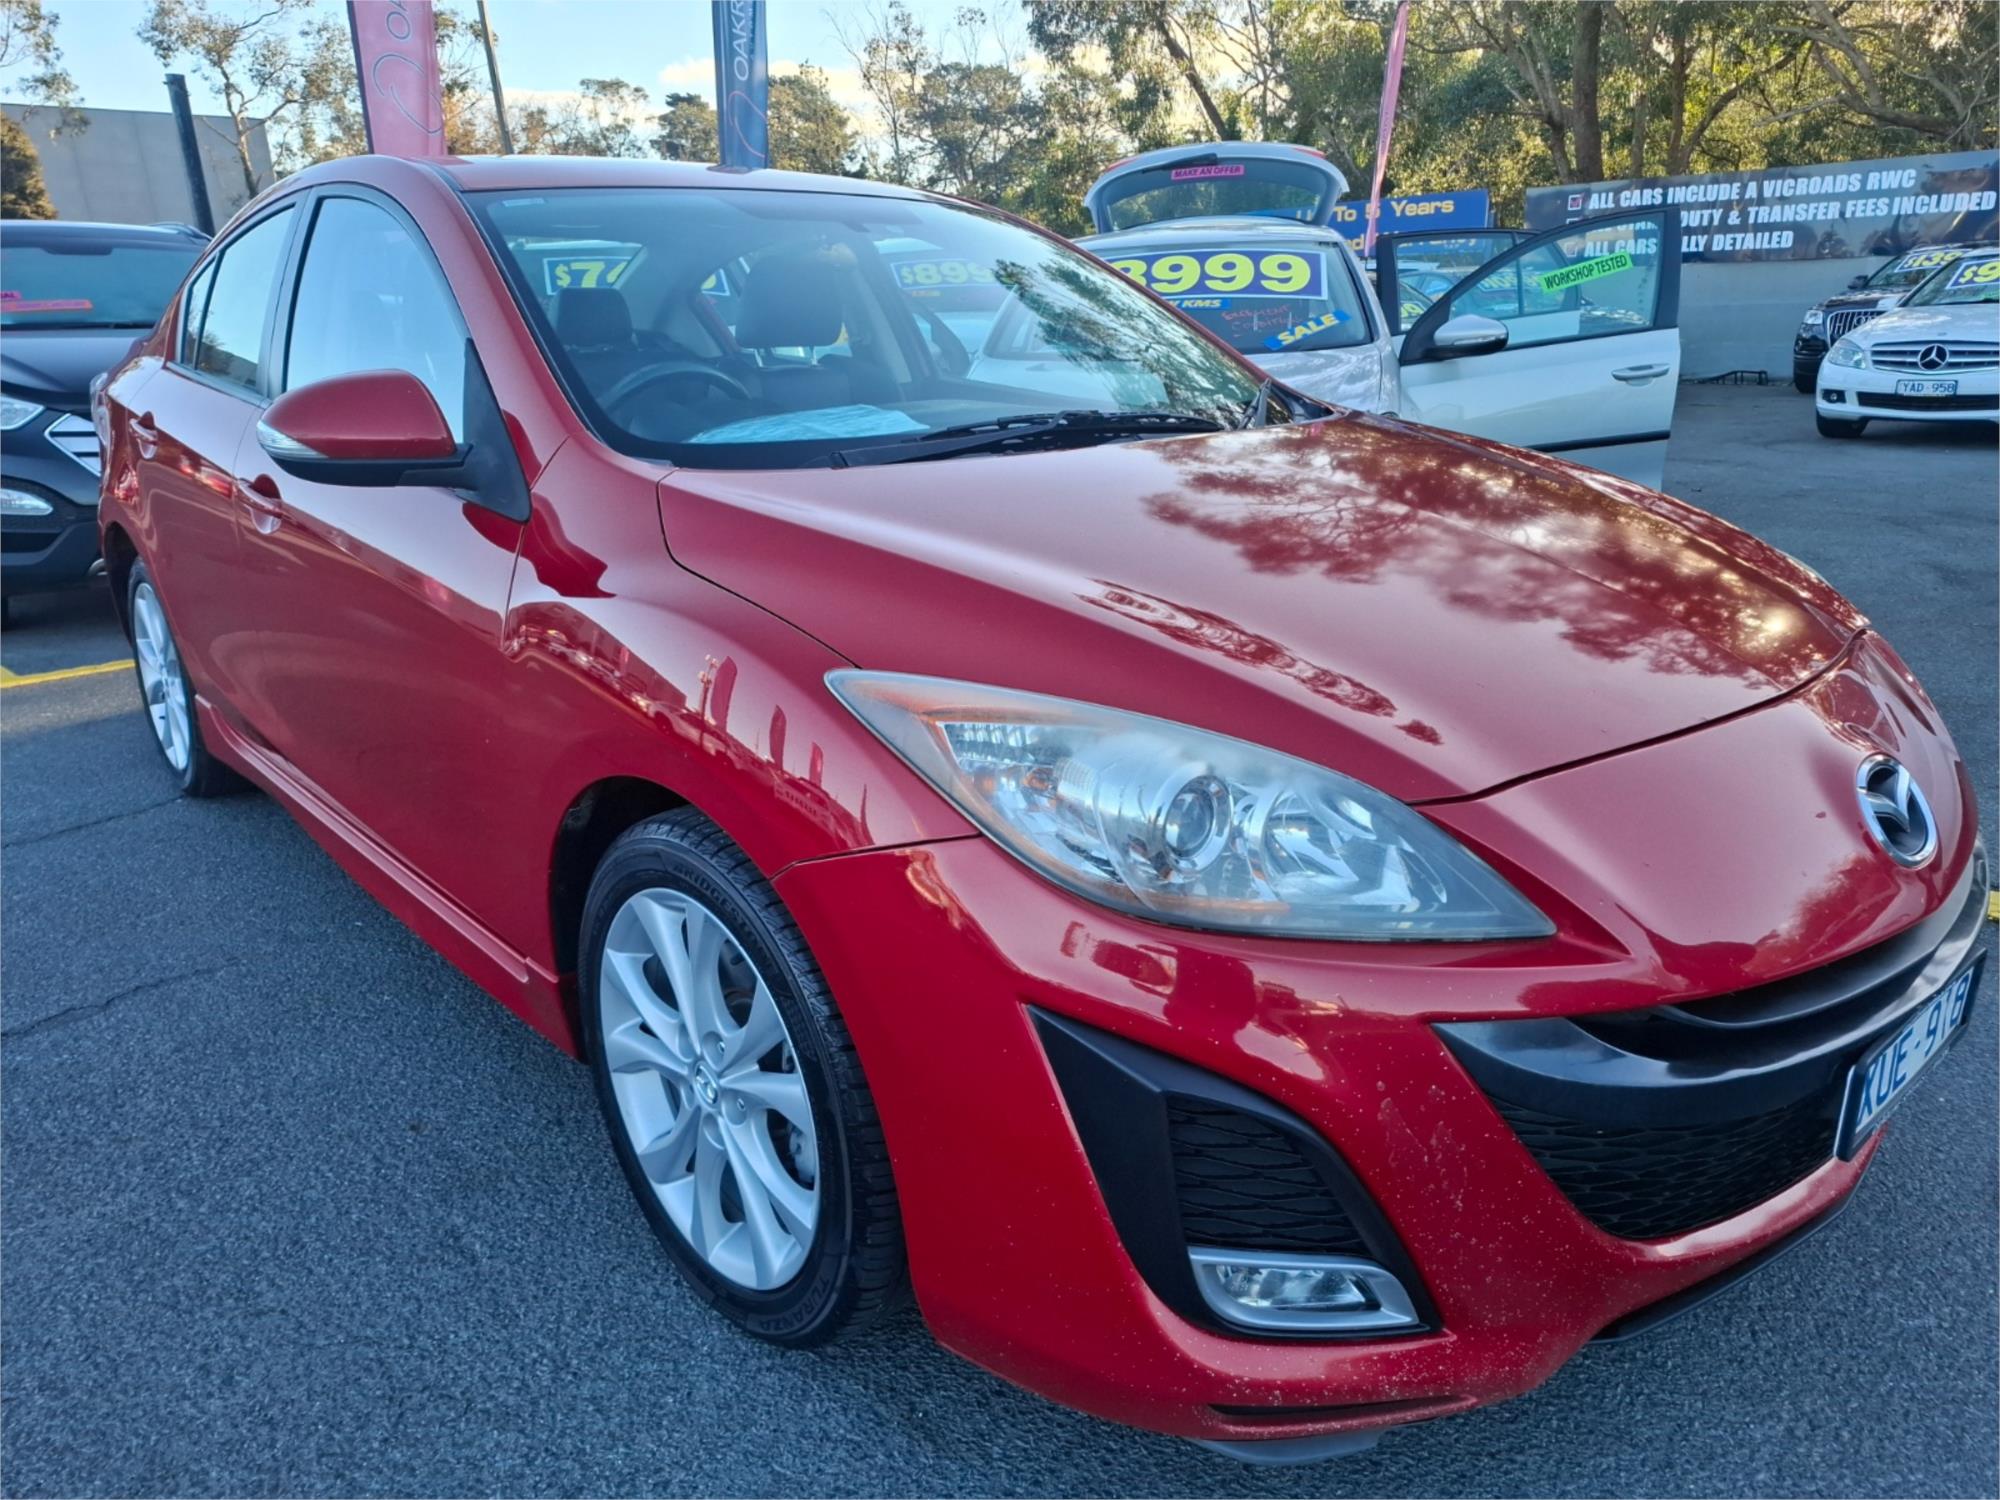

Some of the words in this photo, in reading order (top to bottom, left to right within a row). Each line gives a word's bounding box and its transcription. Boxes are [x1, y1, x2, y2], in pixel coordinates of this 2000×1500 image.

[1175, 169, 1198, 178] MAKE
[1200, 167, 1212, 175] AN
[1214, 166, 1242, 175] OFFER
[1588, 192, 1615, 210] ALL
[1619, 187, 1663, 207] CARS
[1667, 182, 1741, 204] INCLUDE
[1745, 181, 1757, 199] A
[1763, 173, 1861, 198] VICROADS
[1867, 169, 1917, 191] RWC
[1334, 205, 1357, 222] To
[1391, 200, 1455, 217] Years
[1681, 208, 1723, 228] DUTY
[1727, 210, 1741, 225] &
[1747, 202, 1841, 224] TRANSFER
[1845, 197, 1890, 218] FEES
[1892, 191, 1998, 215] INCLUDED
[1584, 241, 1609, 257] ALL
[1615, 238, 1657, 255] CARS
[1681, 234, 1707, 252] LLY
[1712, 231, 1794, 251] DETAILED
[1544, 267, 1596, 289] WORKSHOP
[1594, 254, 1628, 275] TESTED
[1181, 299, 1222, 308] KMS
[1278, 312, 1340, 346] SALE
[1903, 382, 1925, 393] YAD
[1931, 382, 1955, 393] 958
